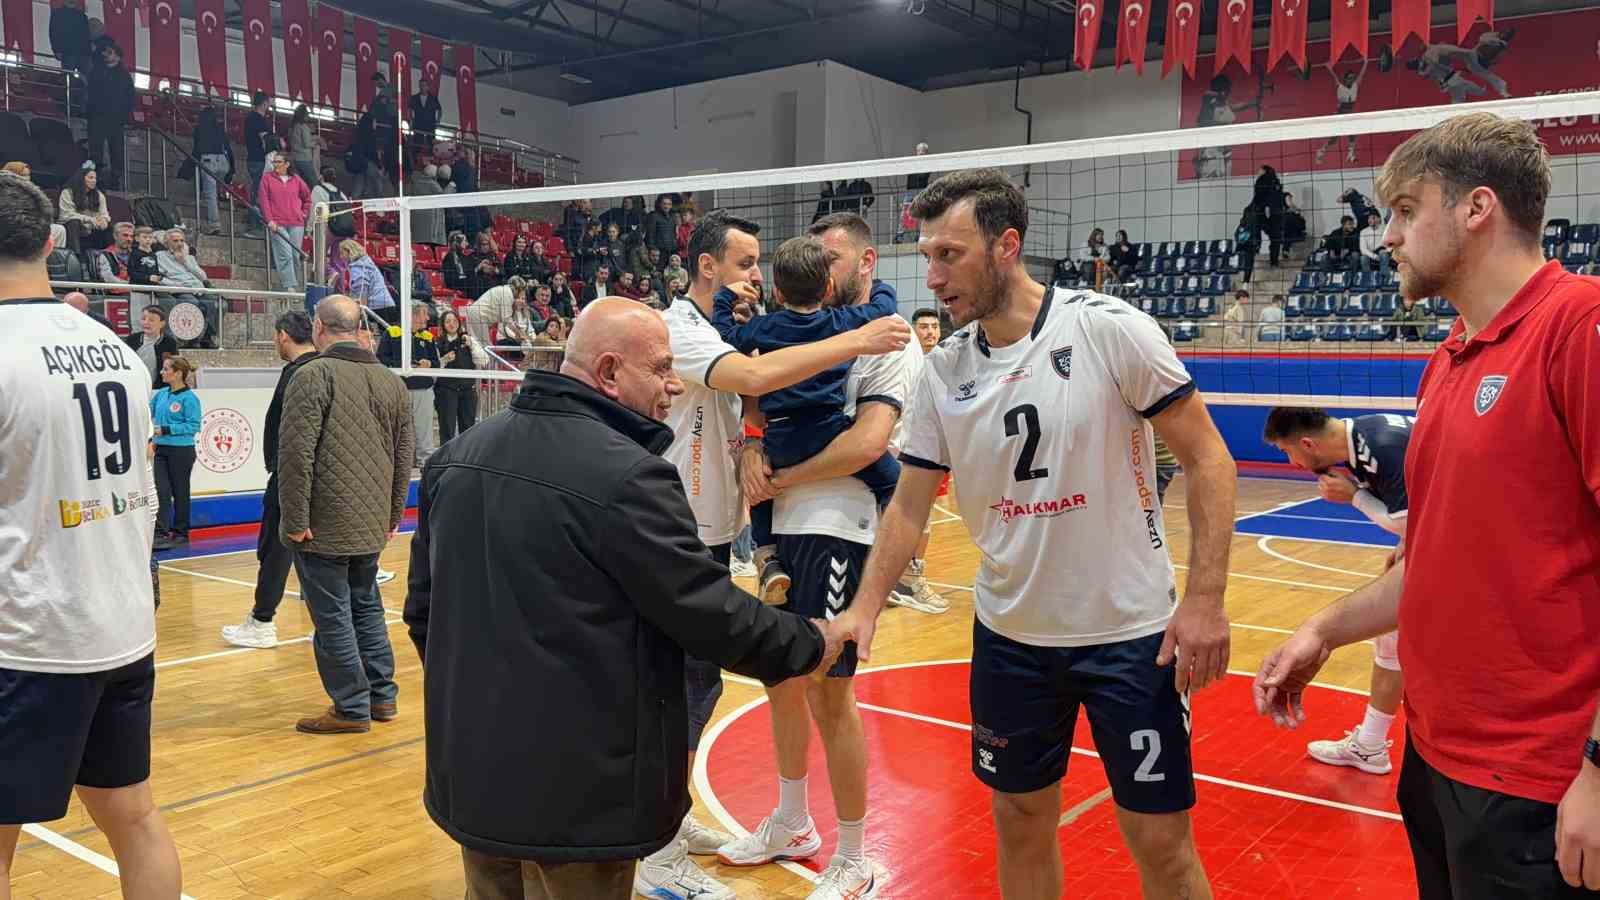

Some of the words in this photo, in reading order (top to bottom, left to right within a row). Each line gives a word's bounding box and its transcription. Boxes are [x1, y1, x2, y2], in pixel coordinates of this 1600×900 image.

[41, 338, 132, 381] AÇIKGÖZ
[72, 380, 133, 481] 19
[691, 406, 705, 497] uzayspor.com
[1003, 403, 1049, 483] 2
[1002, 493, 1088, 519] HALKMAR
[1131, 428, 1163, 550] uzayspor.com
[1129, 728, 1166, 782] 2
